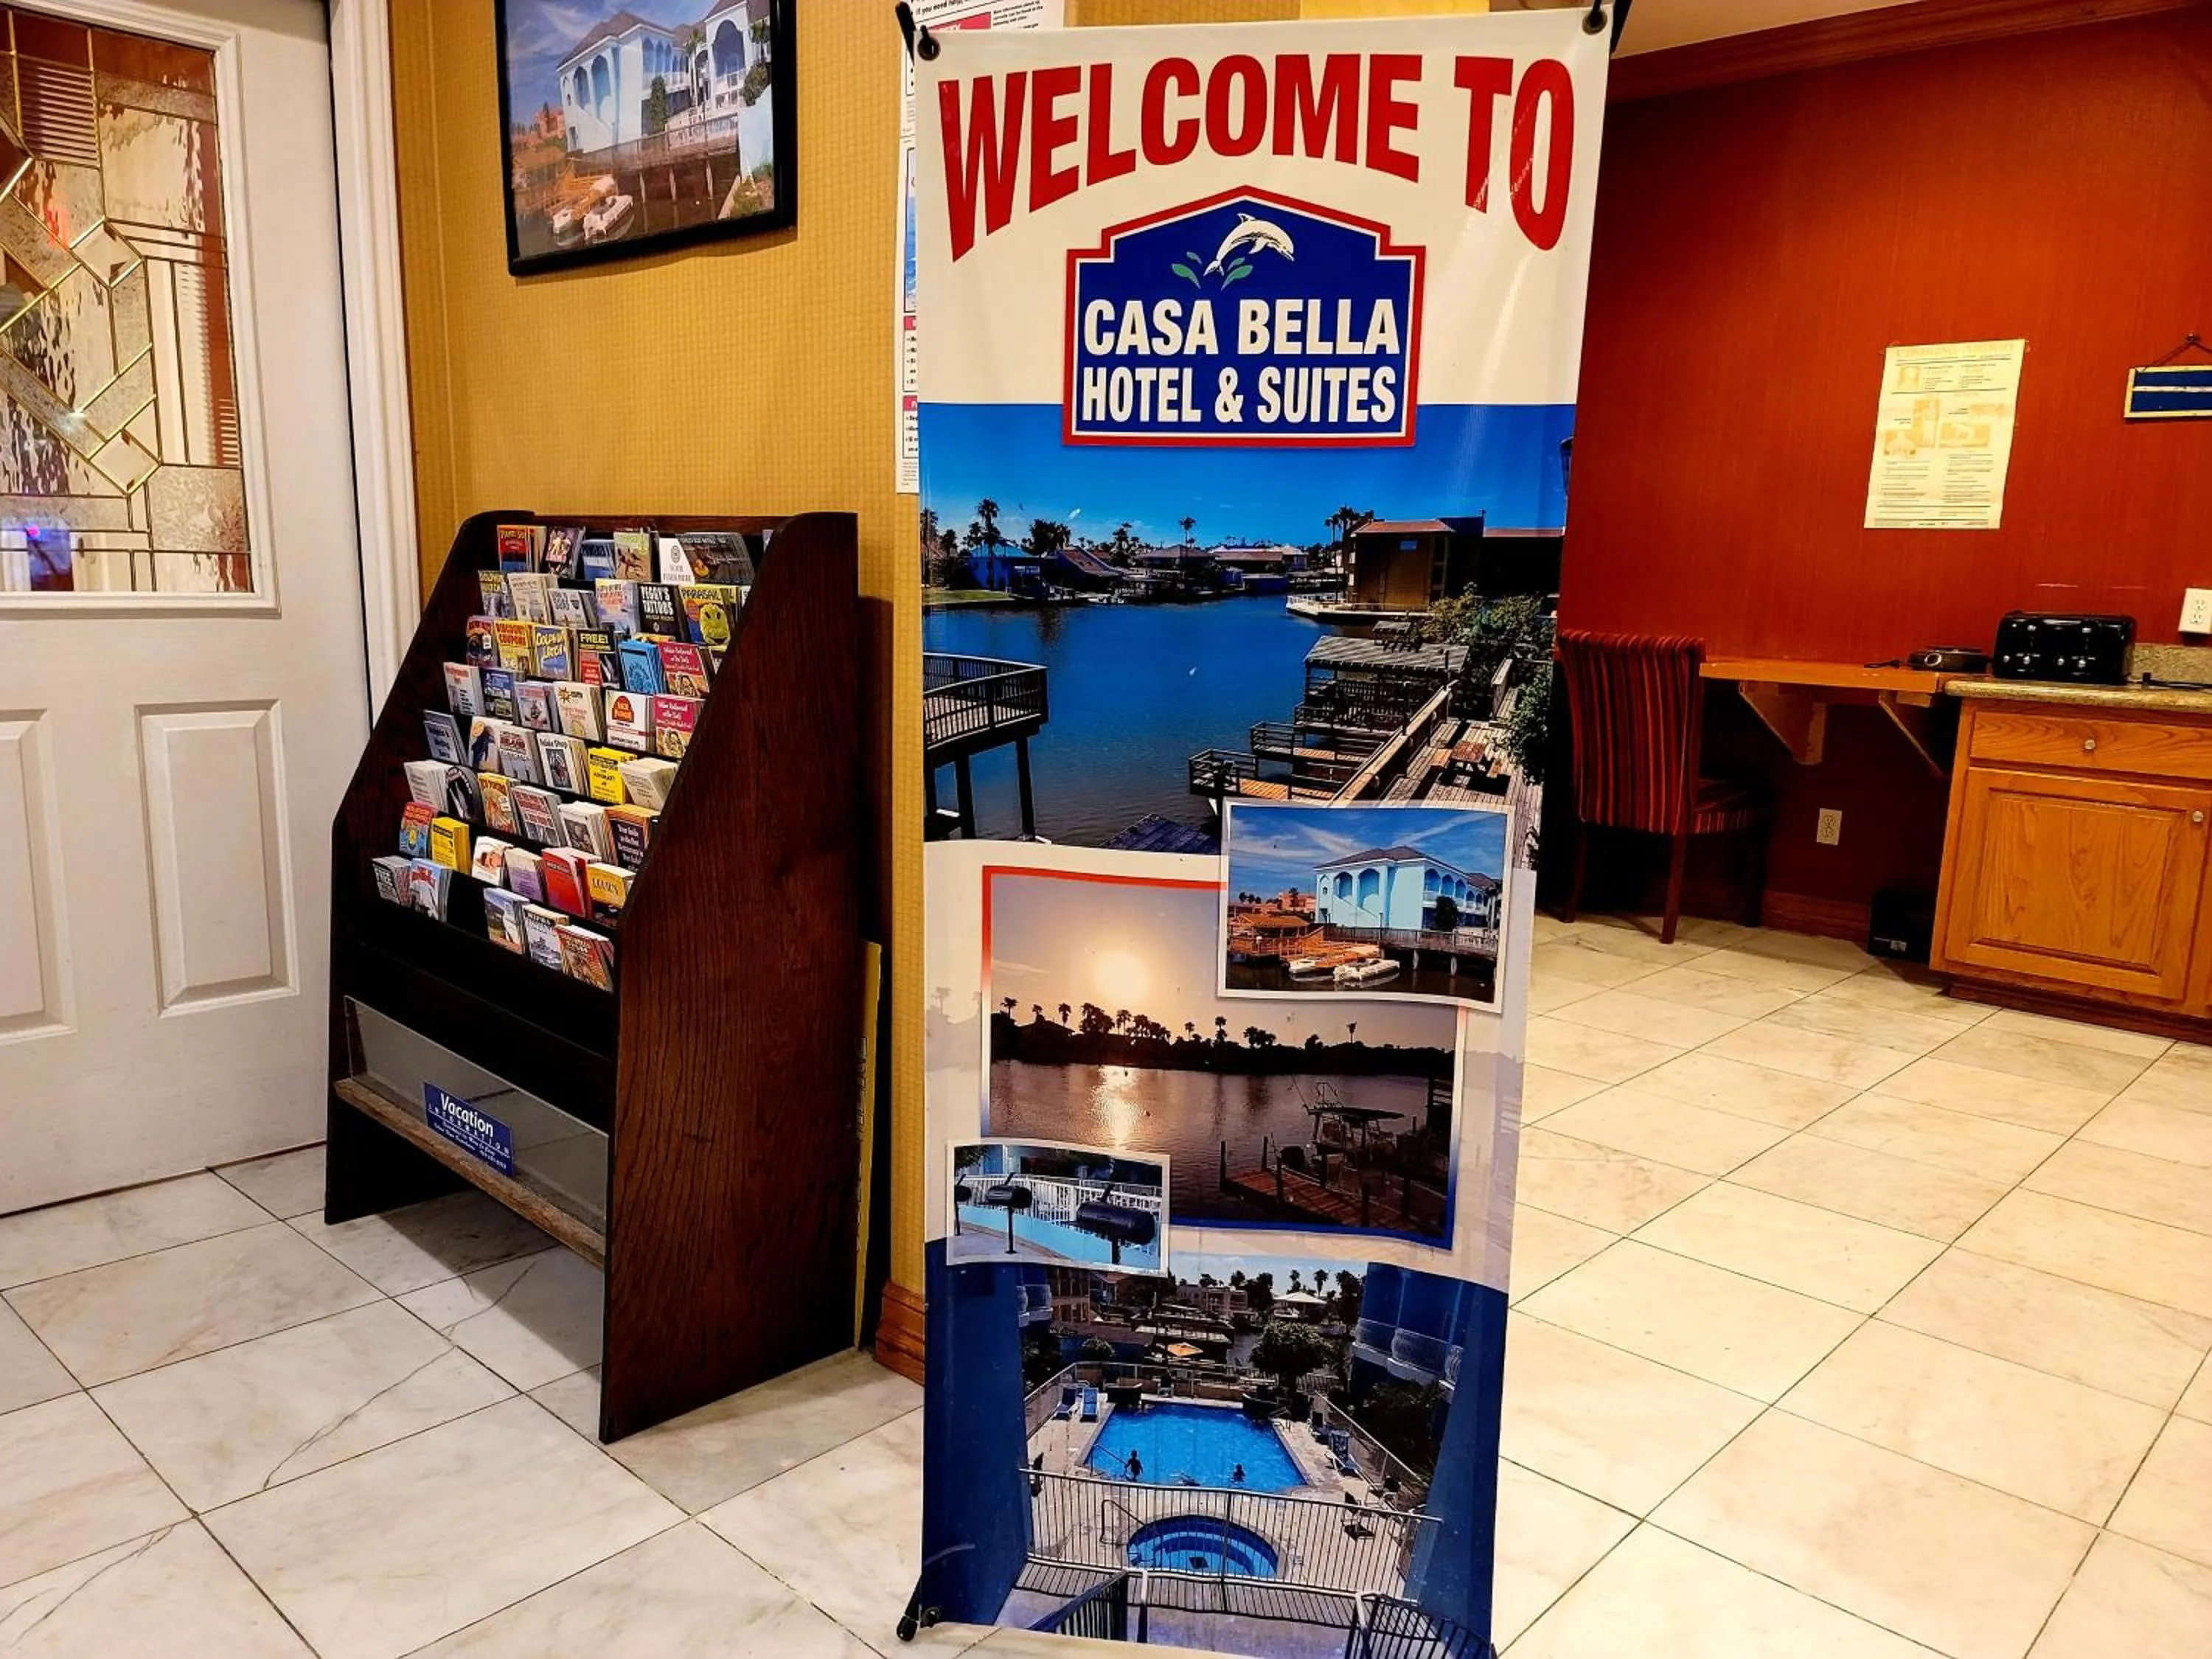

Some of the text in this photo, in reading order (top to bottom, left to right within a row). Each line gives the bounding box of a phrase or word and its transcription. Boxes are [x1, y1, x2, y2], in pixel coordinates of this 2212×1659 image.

[938, 53, 1575, 263] WELCOME TO
[1082, 298, 1400, 356] CASA BELLA
[1081, 366, 1397, 424] HOTEL & SUITES
[580, 633, 608, 644] FREE!
[440, 1092, 494, 1138] Vacation
